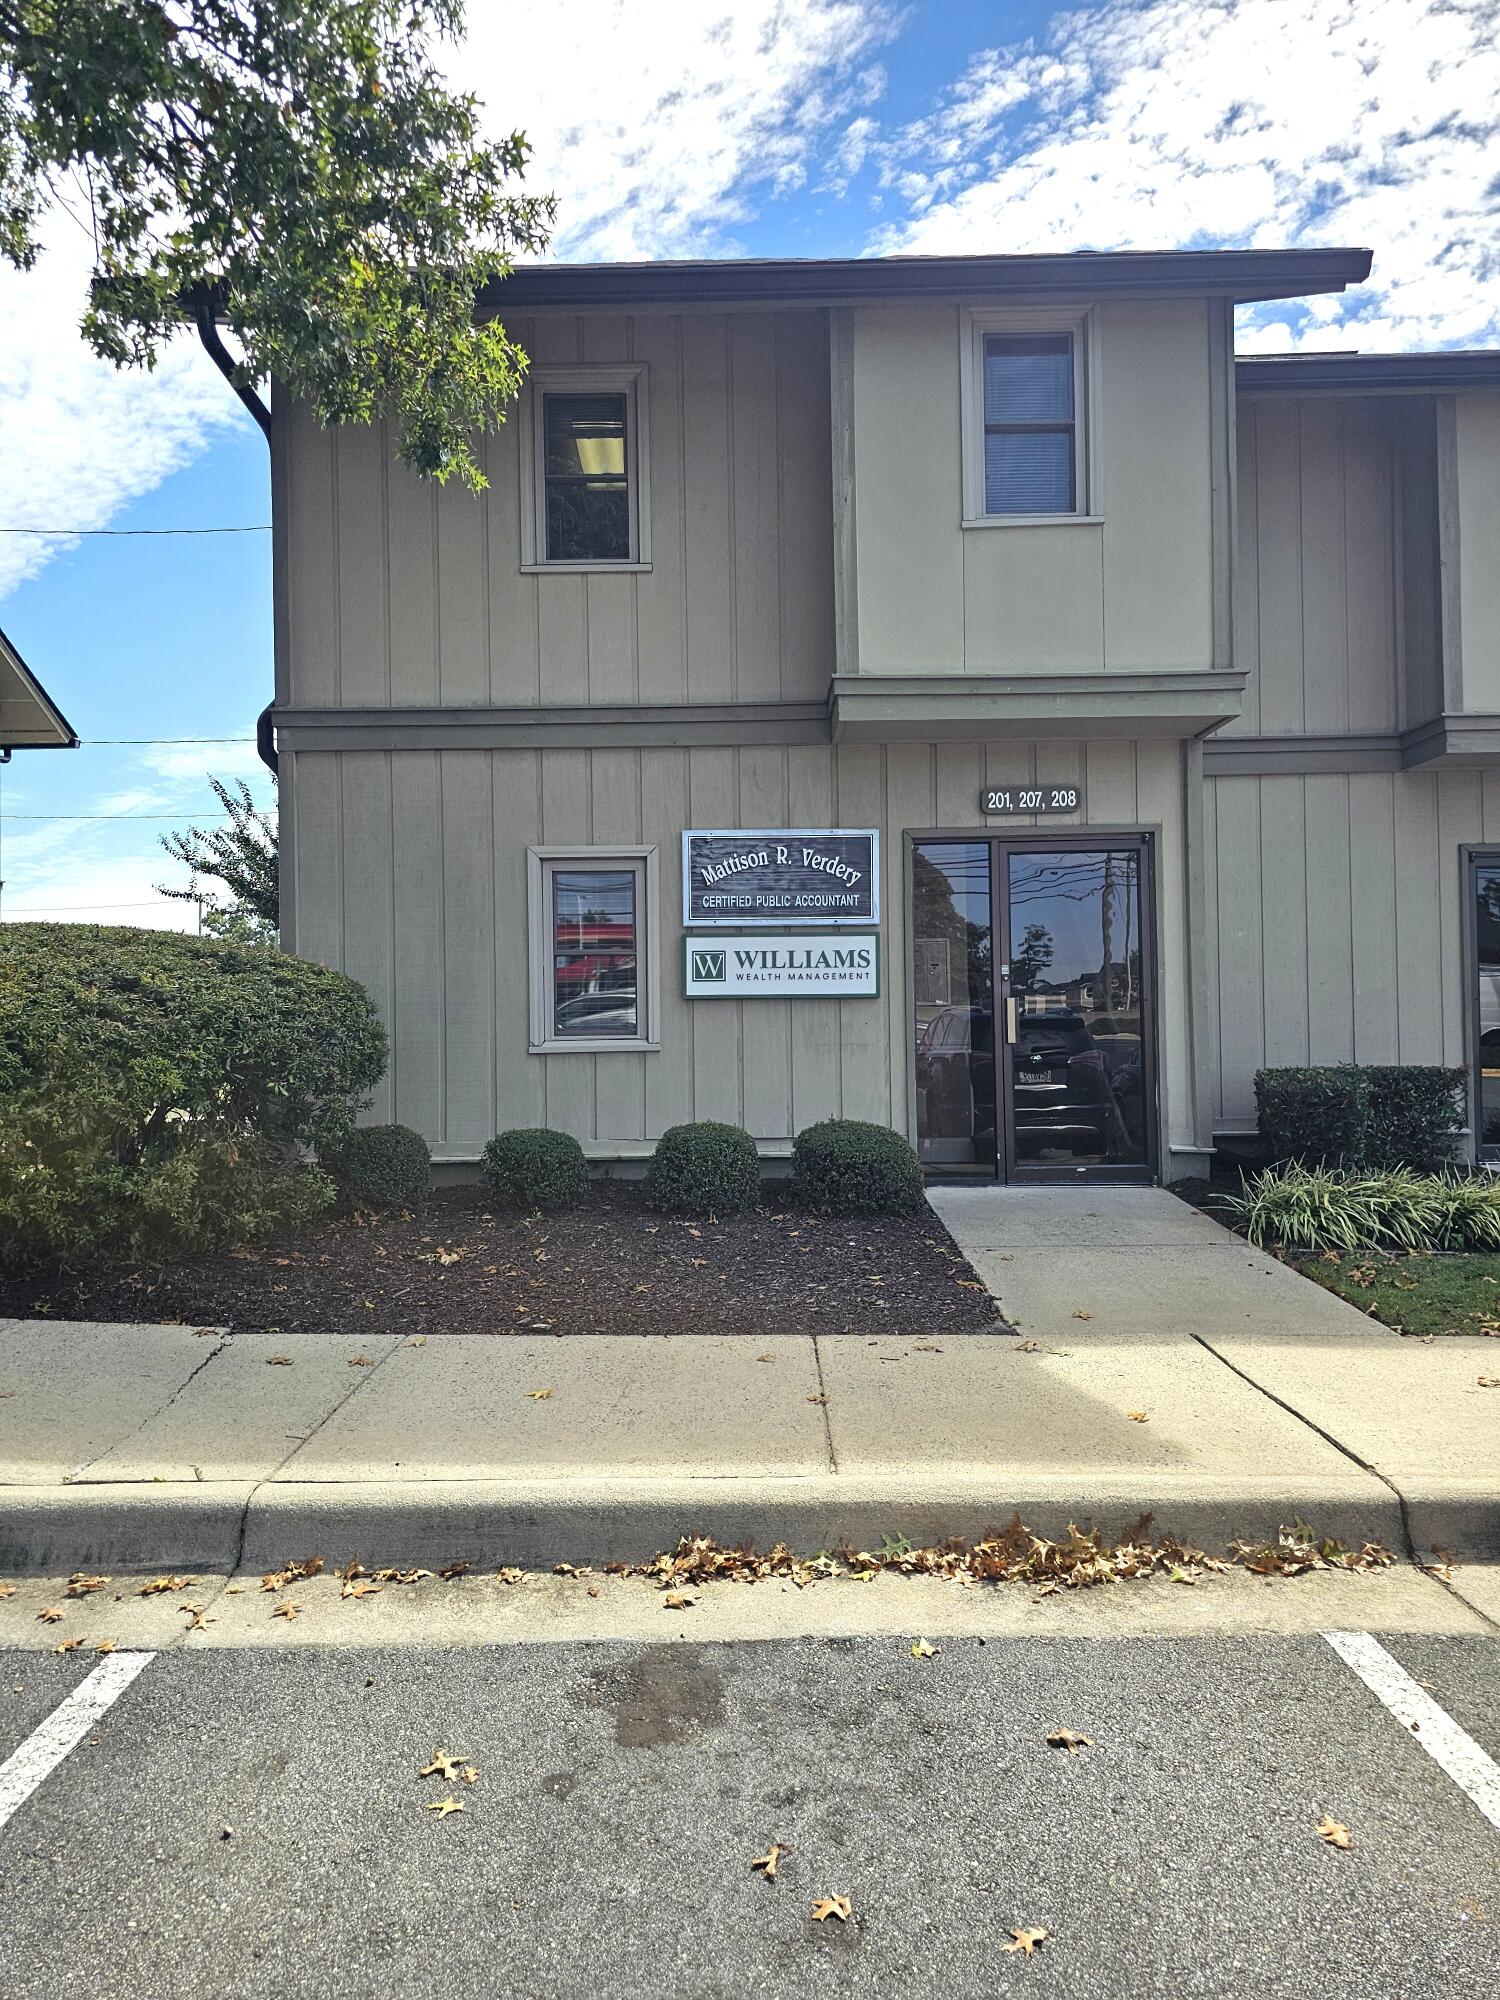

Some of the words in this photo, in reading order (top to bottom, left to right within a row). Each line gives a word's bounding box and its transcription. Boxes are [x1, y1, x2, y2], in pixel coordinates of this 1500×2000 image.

[988, 792, 1013, 811] 201,
[1019, 791, 1046, 810] 207,
[1051, 790, 1077, 807] 208
[700, 851, 769, 886] Mattison
[776, 846, 792, 865] R.
[802, 848, 862, 887] Verdery
[702, 895, 752, 908] CERTIFIED
[756, 895, 791, 907] PUBLIC
[794, 894, 860, 907] ACCOUNTANT
[695, 954, 723, 978] W
[734, 949, 871, 969] WILLIAMS
[736, 973, 781, 981] WEALTH
[788, 972, 871, 980] MANAGEMENT
